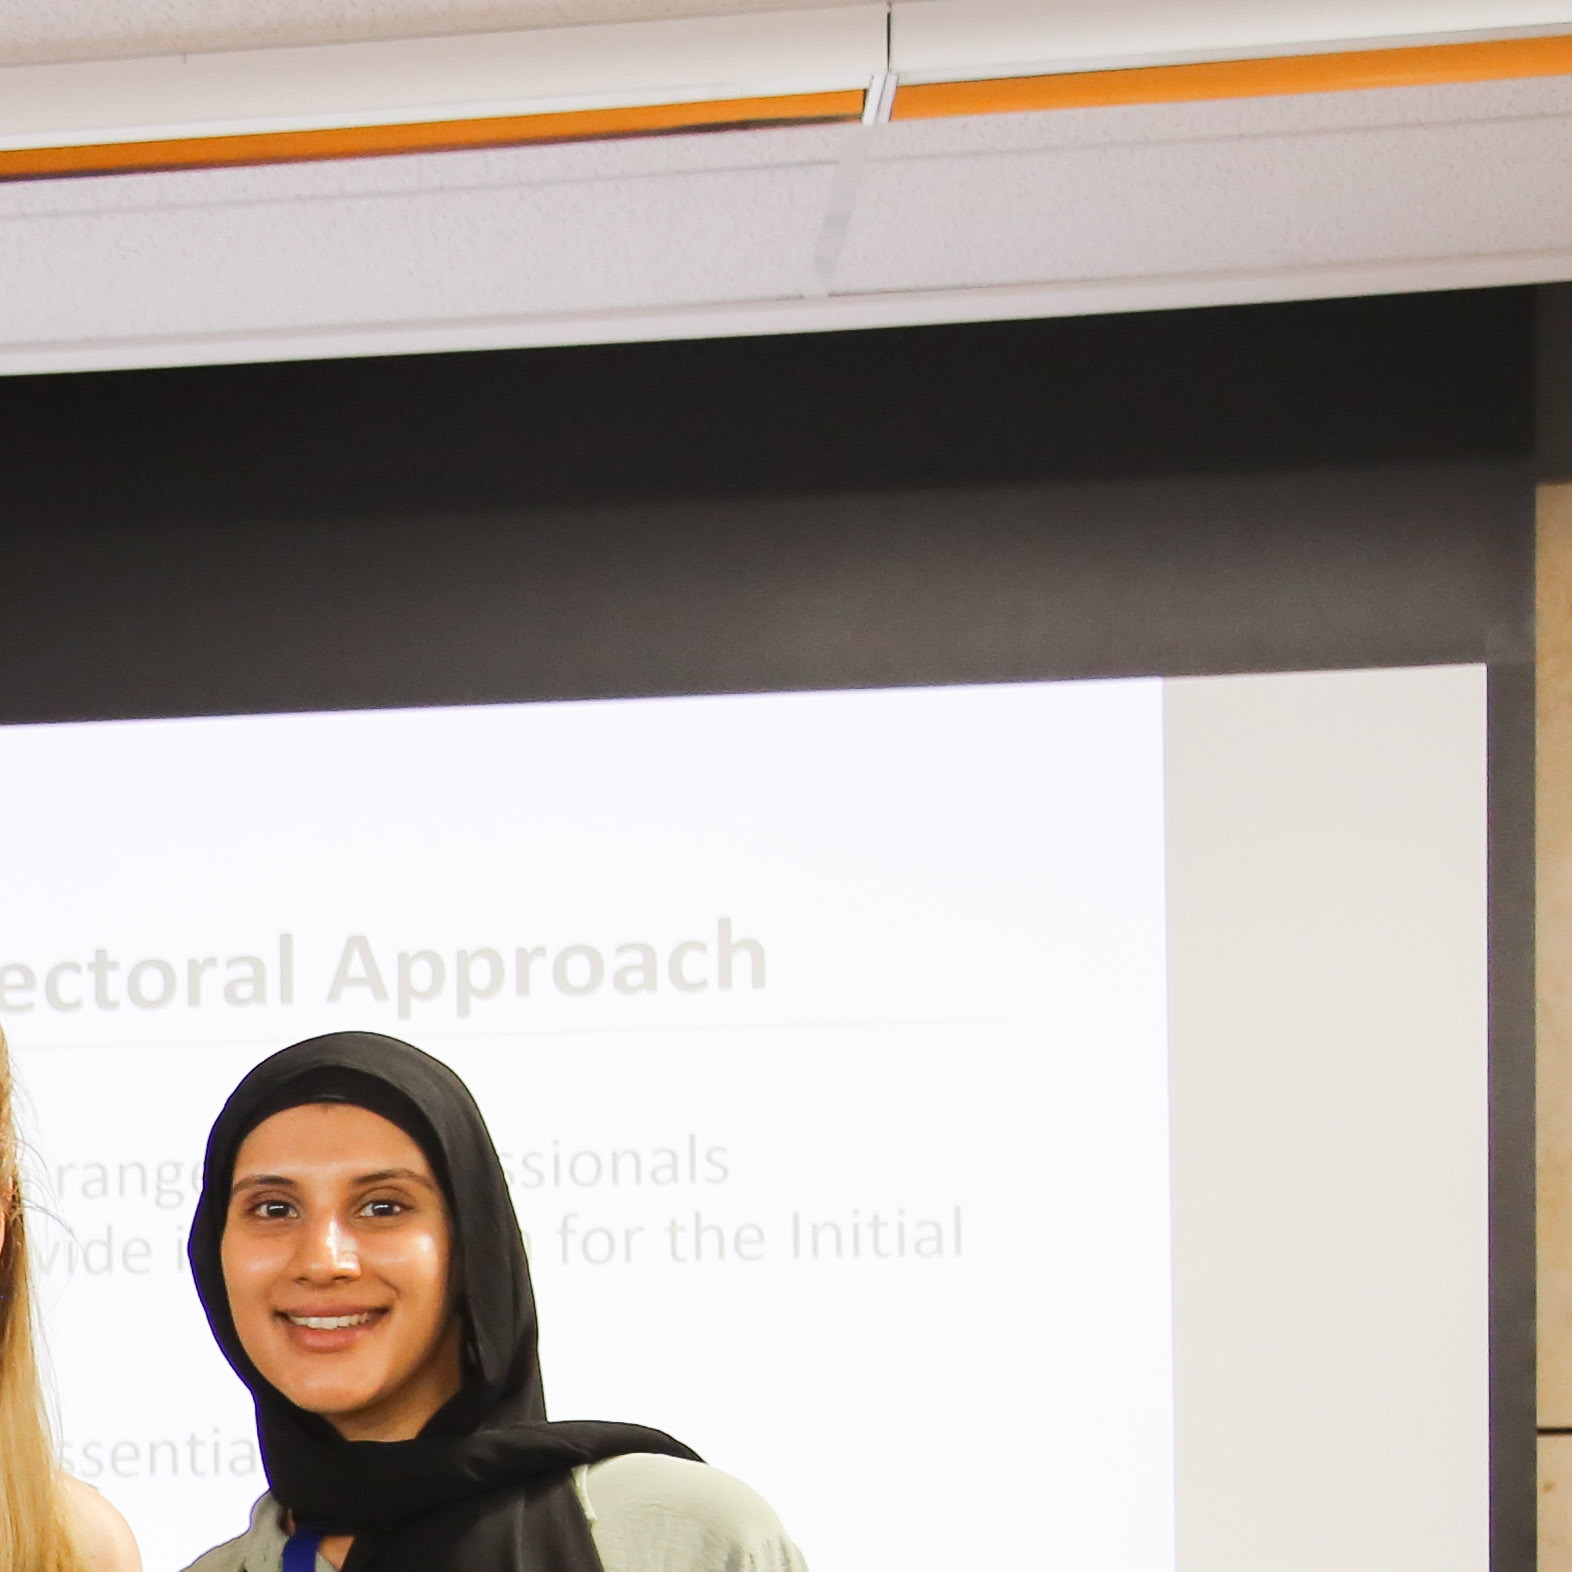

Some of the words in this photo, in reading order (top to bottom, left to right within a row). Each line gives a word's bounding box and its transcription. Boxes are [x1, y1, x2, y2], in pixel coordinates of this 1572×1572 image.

[326, 917, 770, 1022] Approach
[500, 1132, 731, 1190] ssionals
[556, 1210, 645, 1265] for
[664, 1208, 766, 1265] the
[792, 1203, 966, 1260] Initial
[60, 1429, 257, 1480] ssentia
